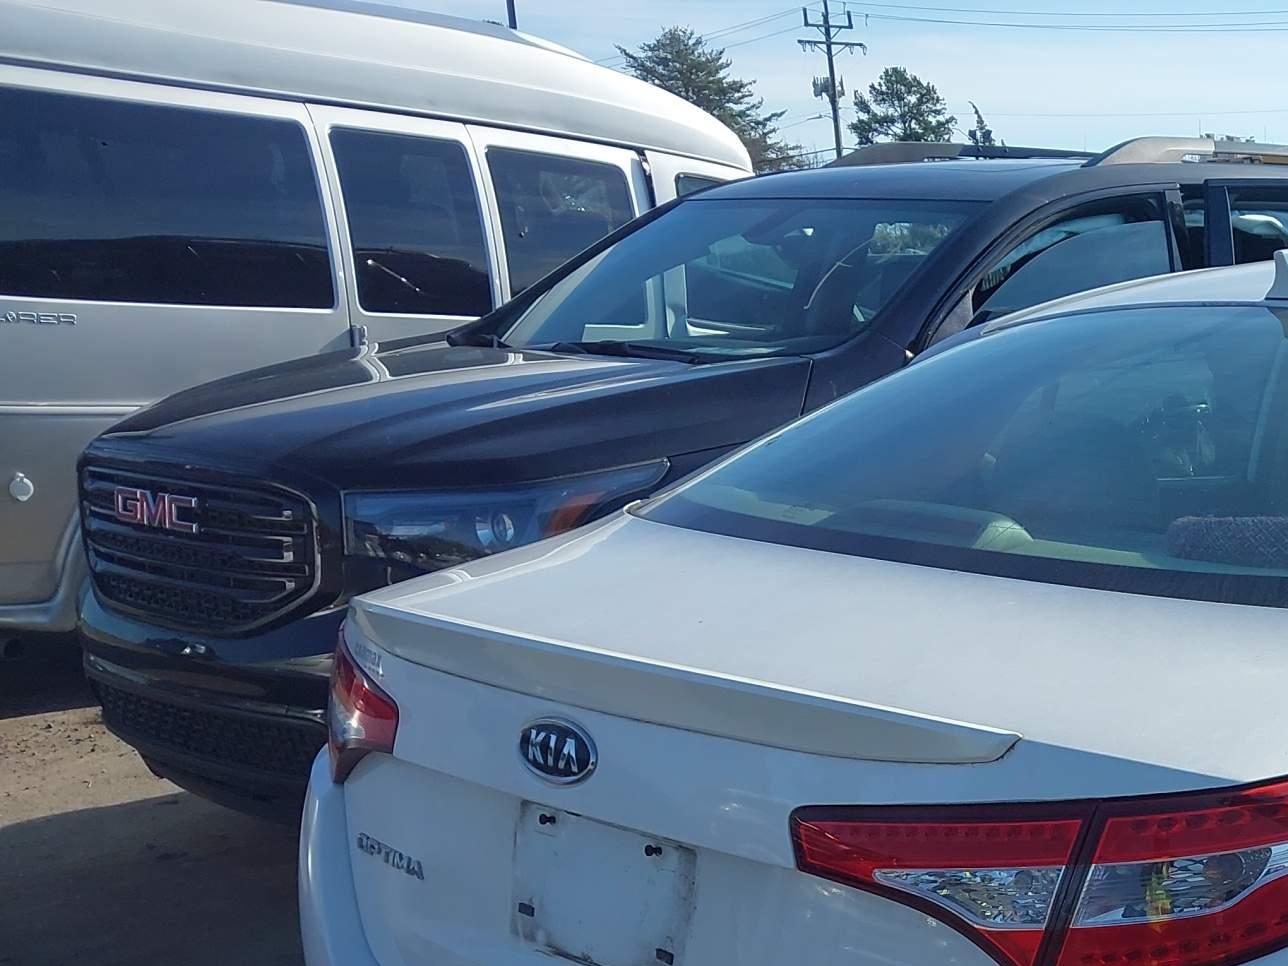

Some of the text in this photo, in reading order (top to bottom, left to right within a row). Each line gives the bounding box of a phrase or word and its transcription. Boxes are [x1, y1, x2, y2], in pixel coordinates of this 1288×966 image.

[114, 486, 198, 533] GMC
[528, 728, 579, 773] KIA
[356, 832, 425, 881] OPTIMA
